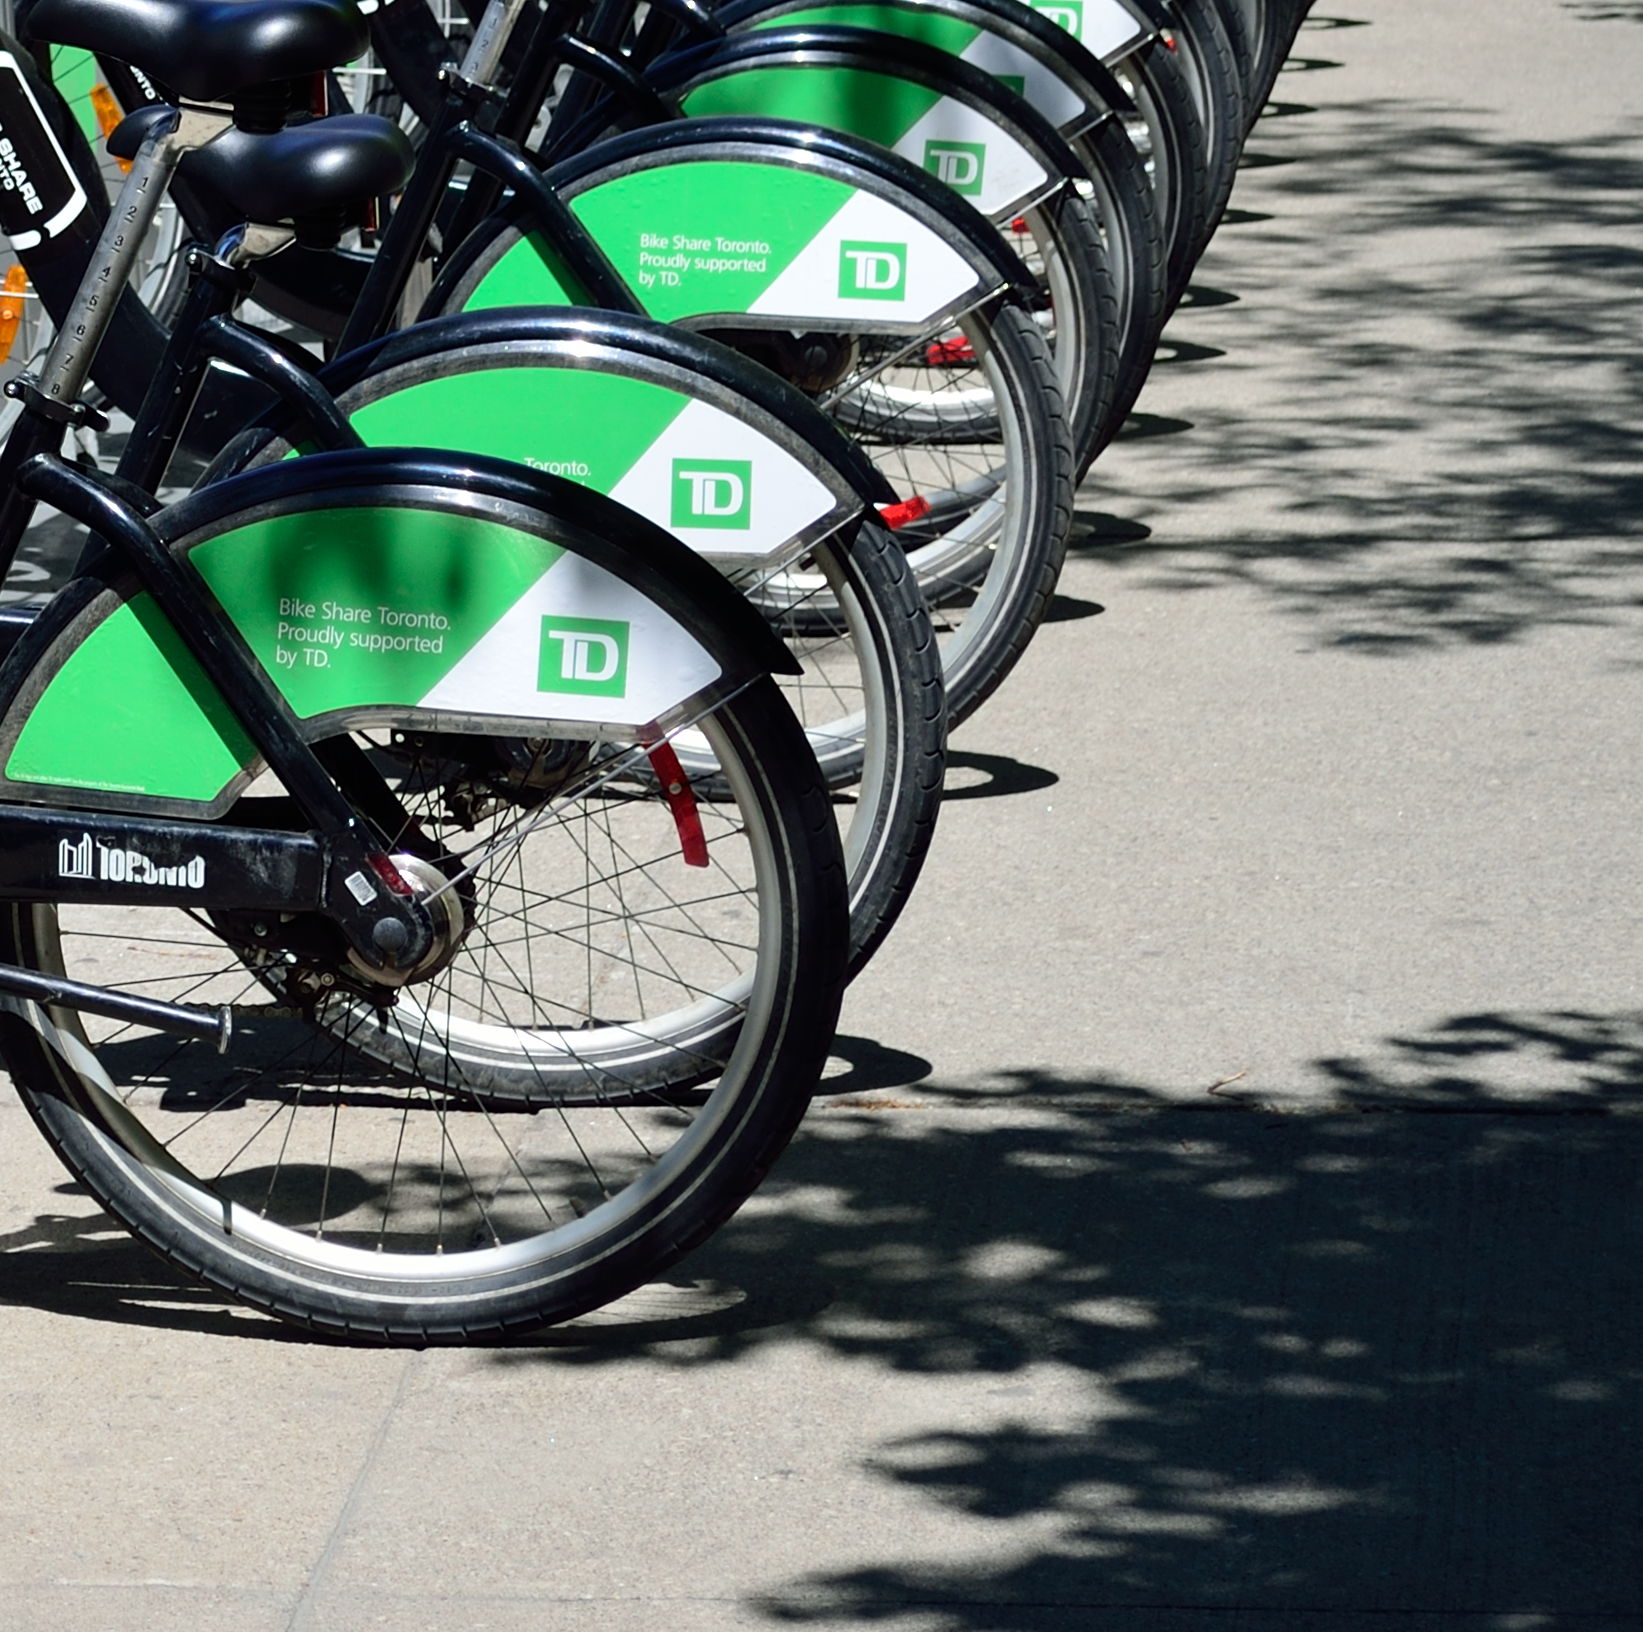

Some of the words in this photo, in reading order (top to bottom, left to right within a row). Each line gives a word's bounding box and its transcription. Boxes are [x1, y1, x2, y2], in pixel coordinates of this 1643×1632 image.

[930, 149, 978, 186] TD
[142, 177, 148, 188] 1
[129, 206, 137, 217] 2
[115, 236, 123, 246] 3
[640, 233, 669, 249] Bike
[672, 235, 711, 252] Share
[715, 236, 772, 254] Toronto.
[103, 266, 111, 278] 4
[639, 252, 690, 272] Proudly
[694, 255, 766, 274] supported
[845, 250, 900, 290] TD
[638, 270, 656, 288] by
[659, 271, 682, 287] TD.
[90, 295, 98, 306] 5
[77, 325, 85, 336] 6
[65, 354, 73, 365] 7
[52, 384, 60, 395] 8
[524, 457, 591, 477] Toronto.
[679, 471, 744, 516] TD
[279, 597, 316, 619] Bike
[321, 601, 372, 624] Share
[378, 606, 451, 631] Toronto.
[277, 622, 344, 649] Proudly
[349, 631, 444, 654] supported
[276, 645, 298, 669] by
[303, 648, 331, 668] TD.
[549, 630, 619, 682] TD
